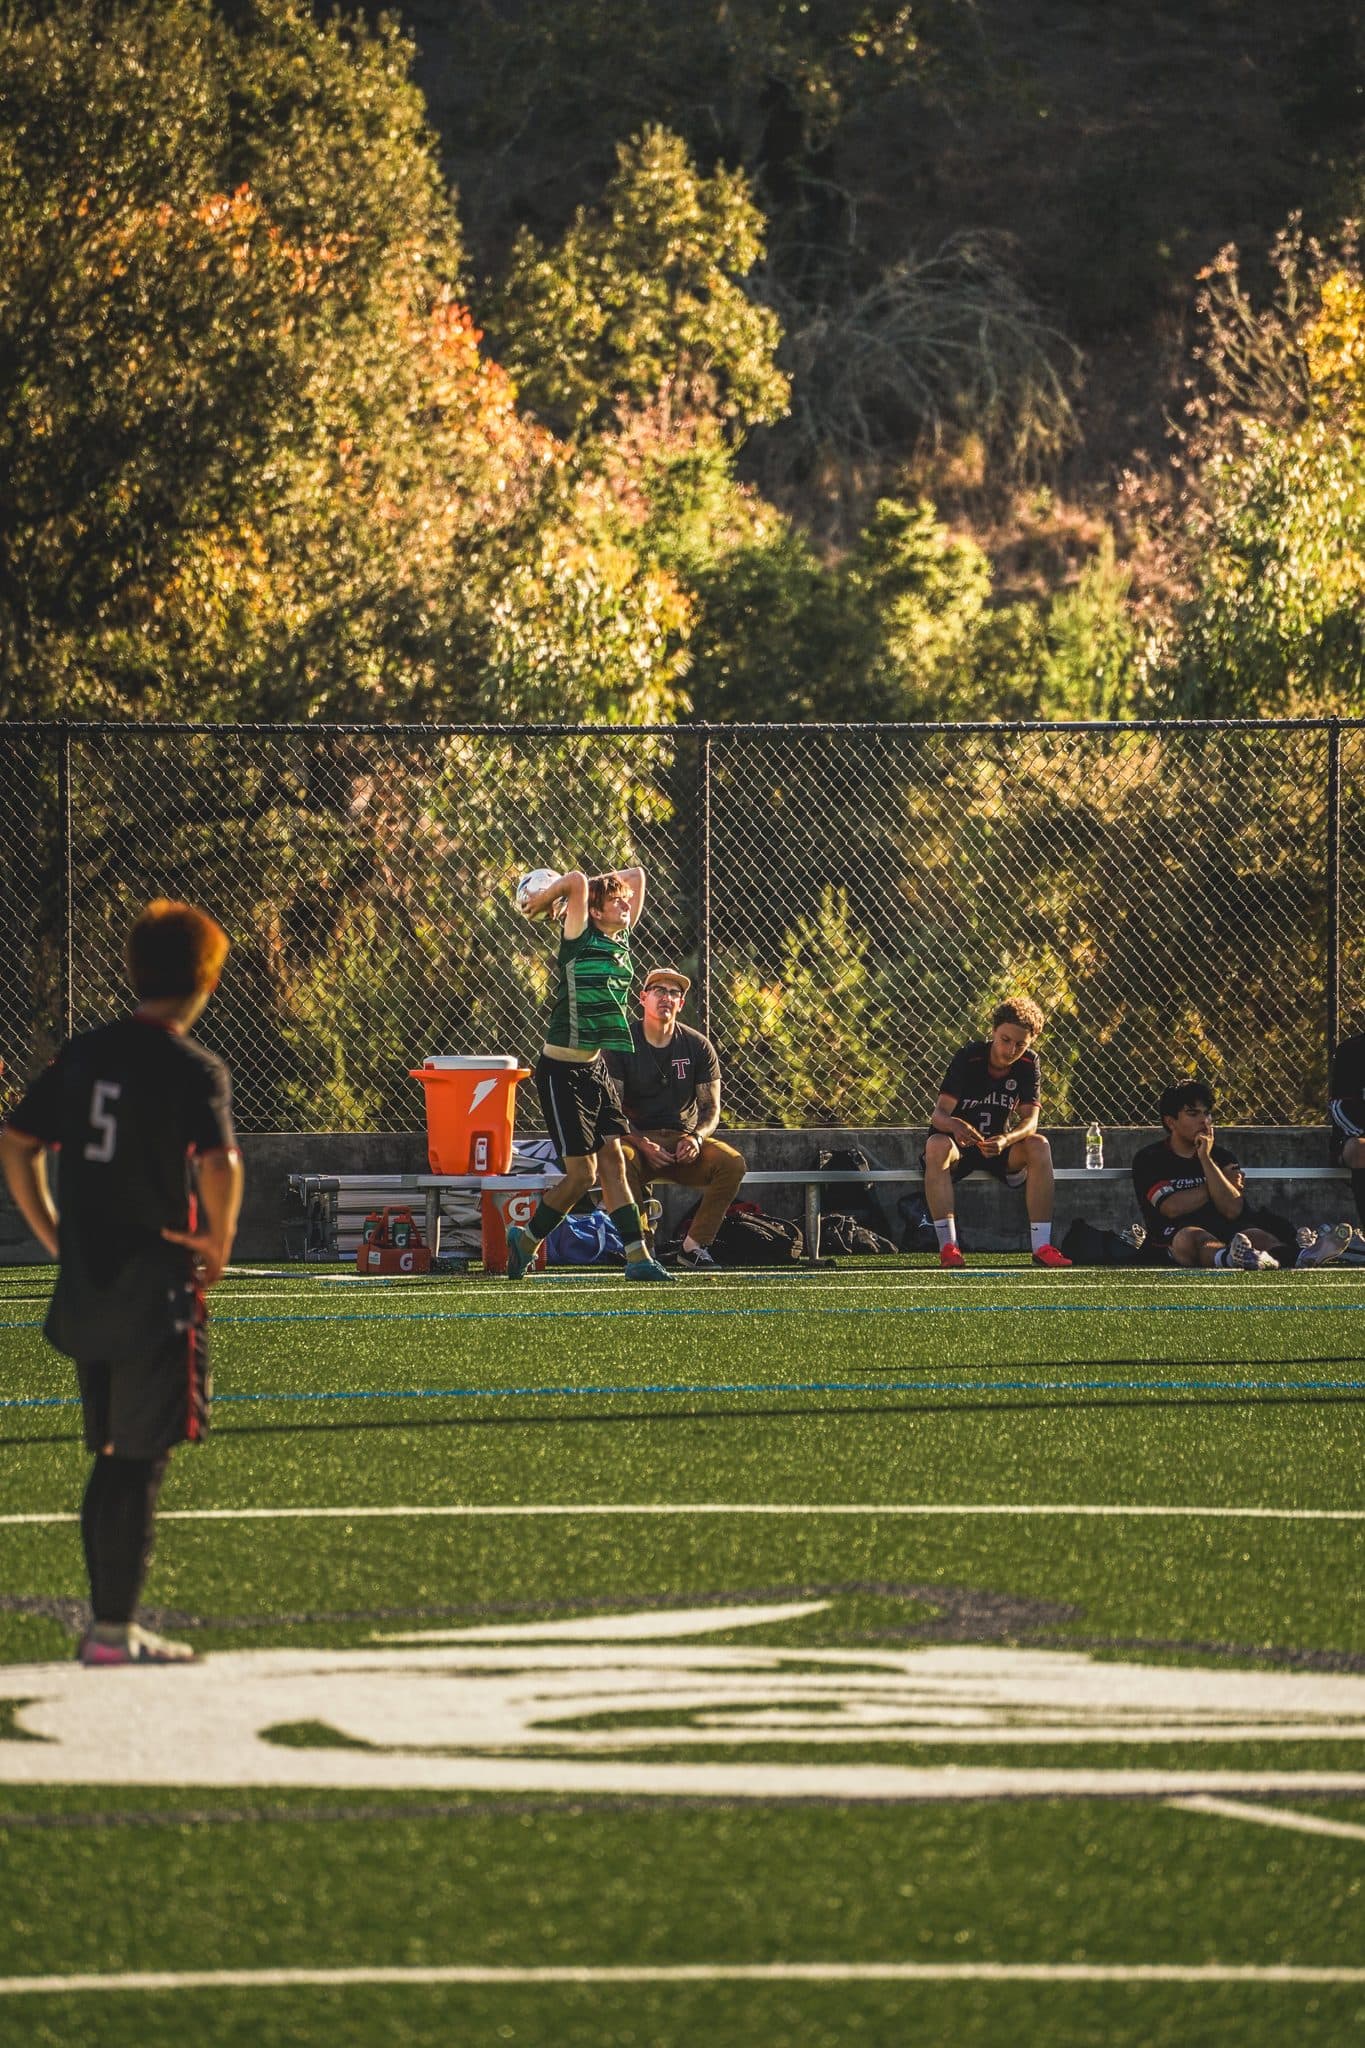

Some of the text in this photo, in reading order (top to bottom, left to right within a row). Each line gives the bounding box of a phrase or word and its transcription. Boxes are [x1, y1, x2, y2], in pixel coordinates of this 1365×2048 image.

[672, 1058, 690, 1079] T
[84, 1080, 121, 1163] 5
[979, 1112, 992, 1134] 2
[509, 1196, 531, 1221] G
[396, 1233, 406, 1246] G
[400, 1252, 413, 1271] G
